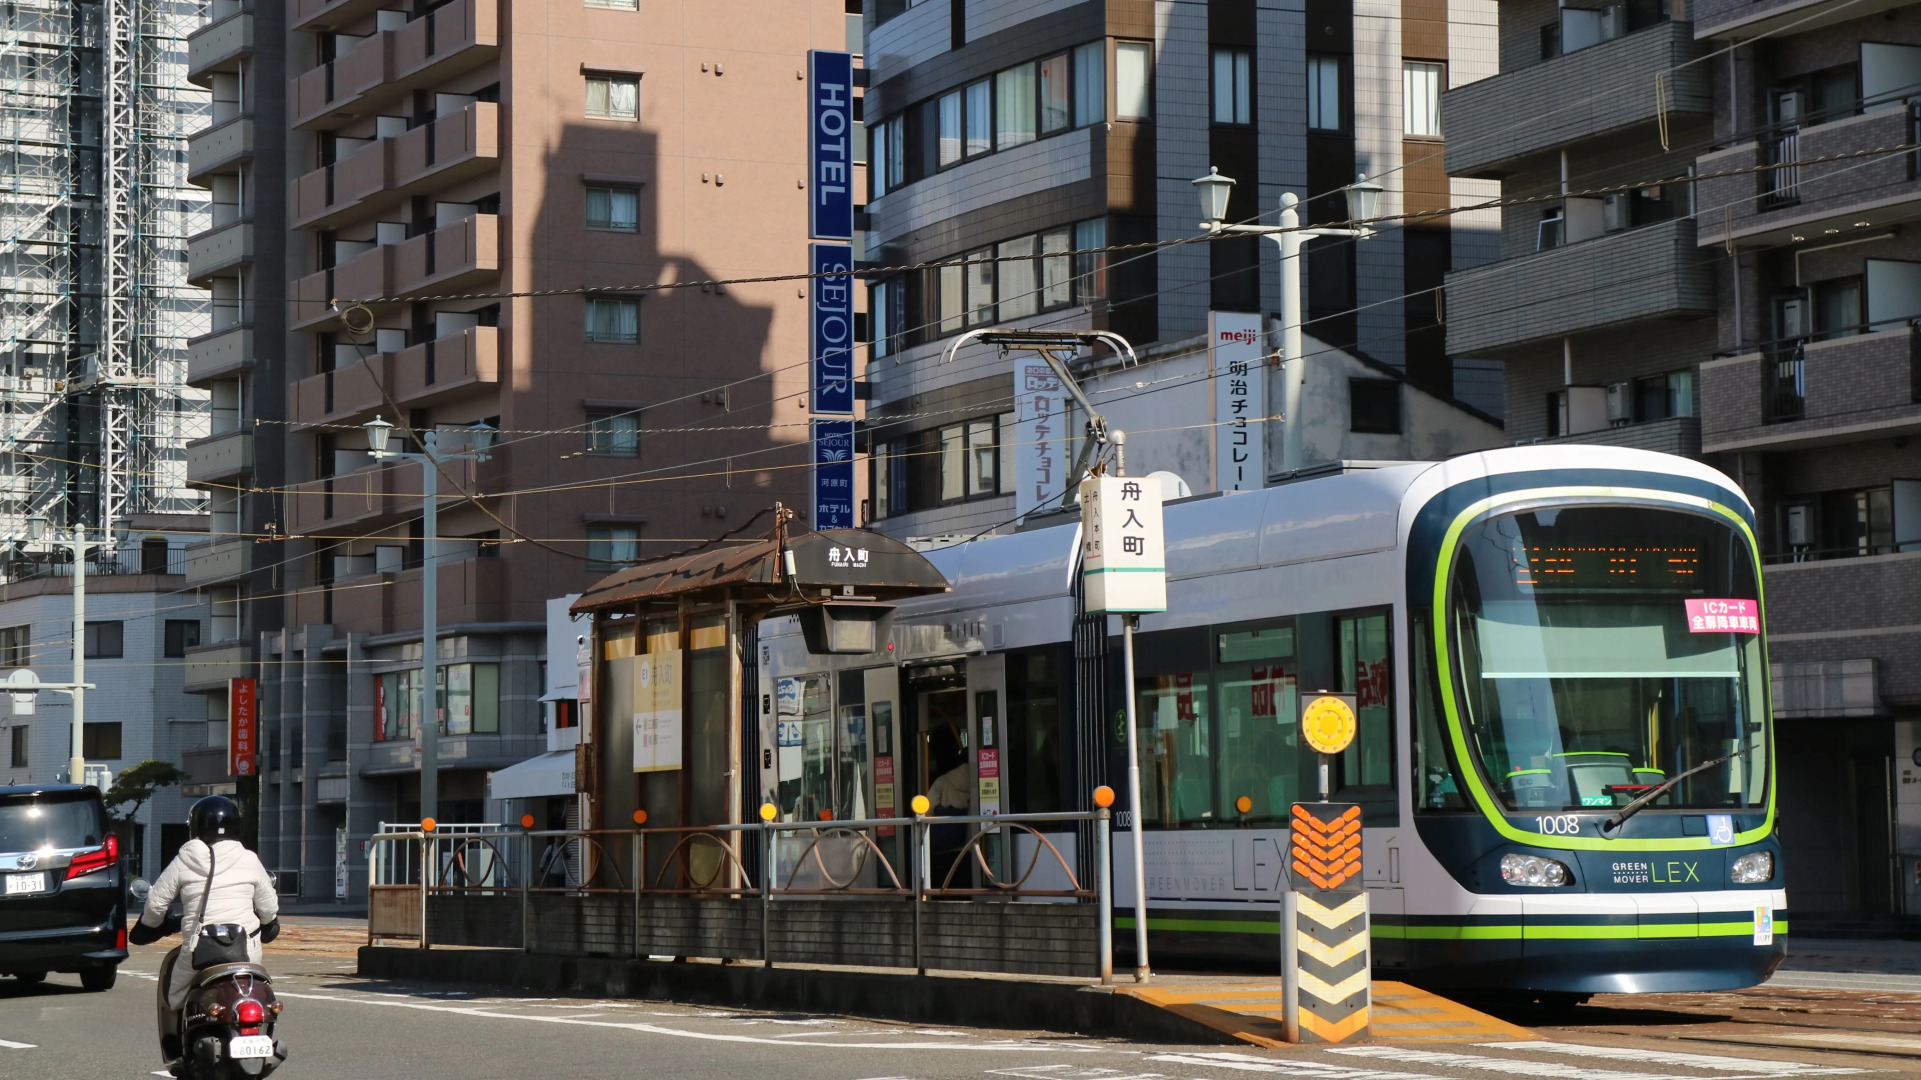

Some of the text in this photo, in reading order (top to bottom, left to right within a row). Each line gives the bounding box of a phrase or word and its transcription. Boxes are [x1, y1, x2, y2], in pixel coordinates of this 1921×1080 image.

[820, 82, 846, 206] HOTEL
[816, 262, 848, 396] SEJOUR
[1220, 329, 1256, 345] meiji
[818, 438, 850, 448] SEJOUR
[821, 478, 848, 488] 河原町
[818, 504, 851, 514] ホテル
[831, 514, 838, 524] &
[1121, 481, 1146, 556] 舟入町
[828, 547, 870, 563] 舟入町
[1703, 601, 1746, 614] ICカード
[238, 683, 248, 752] よしたか歯科
[1581, 797, 1612, 806] ワンマン
[1115, 811, 1132, 827] 1008
[1535, 816, 1580, 834] 1008
[1232, 838, 1291, 891] LEX
[1612, 862, 1648, 871] GREEN
[1651, 861, 1700, 883] LEX
[16, 879, 42, 891] 10-31
[1613, 875, 1649, 884] MOVER
[239, 1045, 271, 1056] 80162
